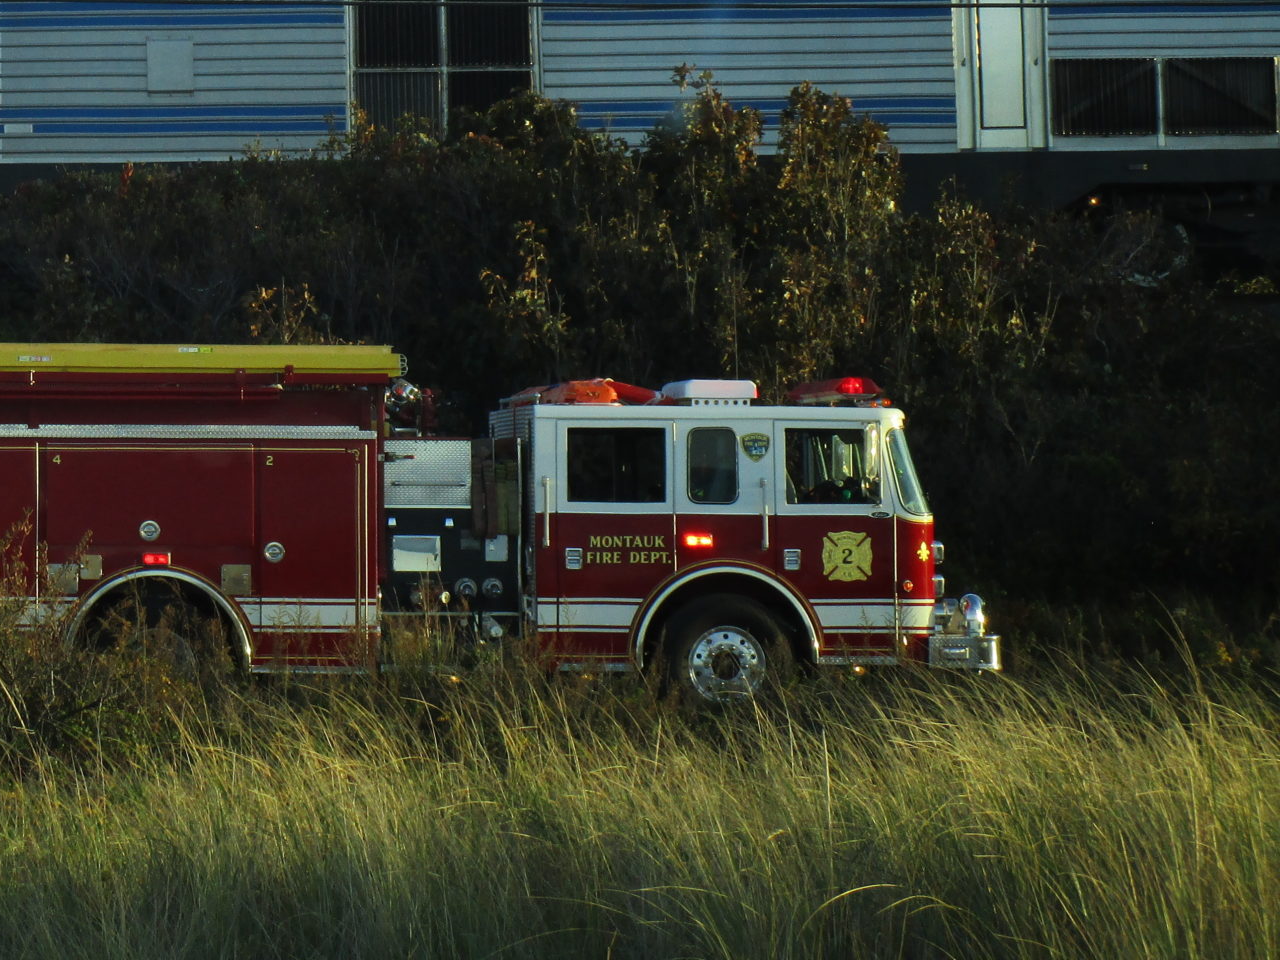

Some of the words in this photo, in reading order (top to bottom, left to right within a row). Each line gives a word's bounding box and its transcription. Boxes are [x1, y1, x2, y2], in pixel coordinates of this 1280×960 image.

[52, 454, 61, 465] 4
[266, 455, 274, 465] 2
[589, 535, 665, 548] MONTAUK
[586, 551, 622, 564] FIRE
[629, 551, 672, 564] DEPT.
[842, 548, 853, 564] 2
